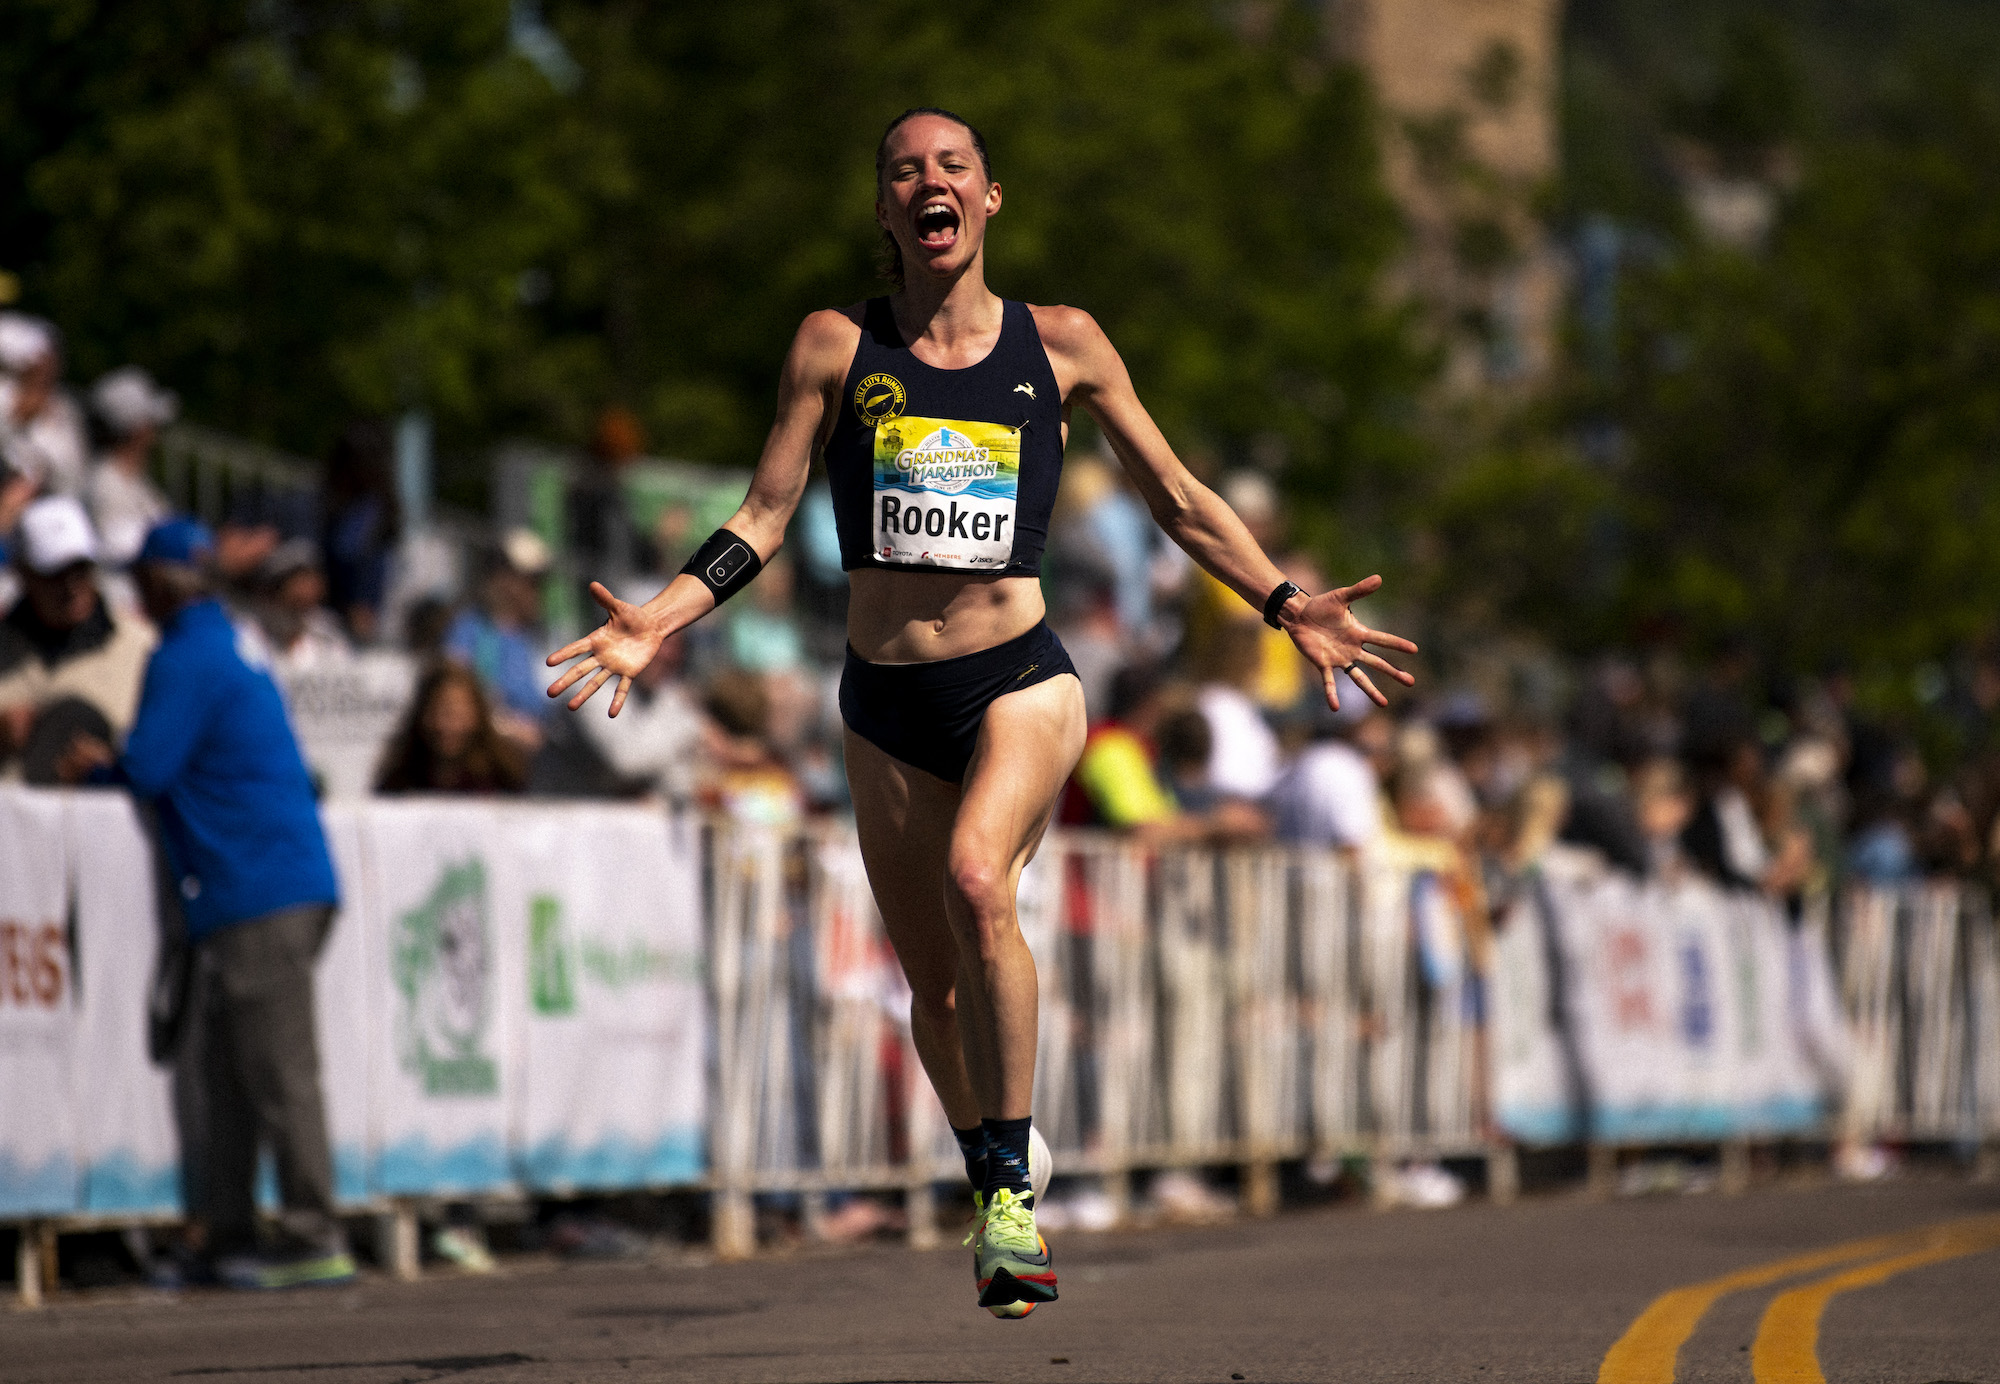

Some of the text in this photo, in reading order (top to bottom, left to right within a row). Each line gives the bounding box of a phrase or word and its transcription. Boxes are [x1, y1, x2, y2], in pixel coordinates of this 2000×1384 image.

[856, 375, 904, 404] MILL CITY RUNNING
[897, 448, 988, 471] GRANDMA'S
[911, 463, 996, 483] MARATHON
[880, 495, 1009, 542] Rooker
